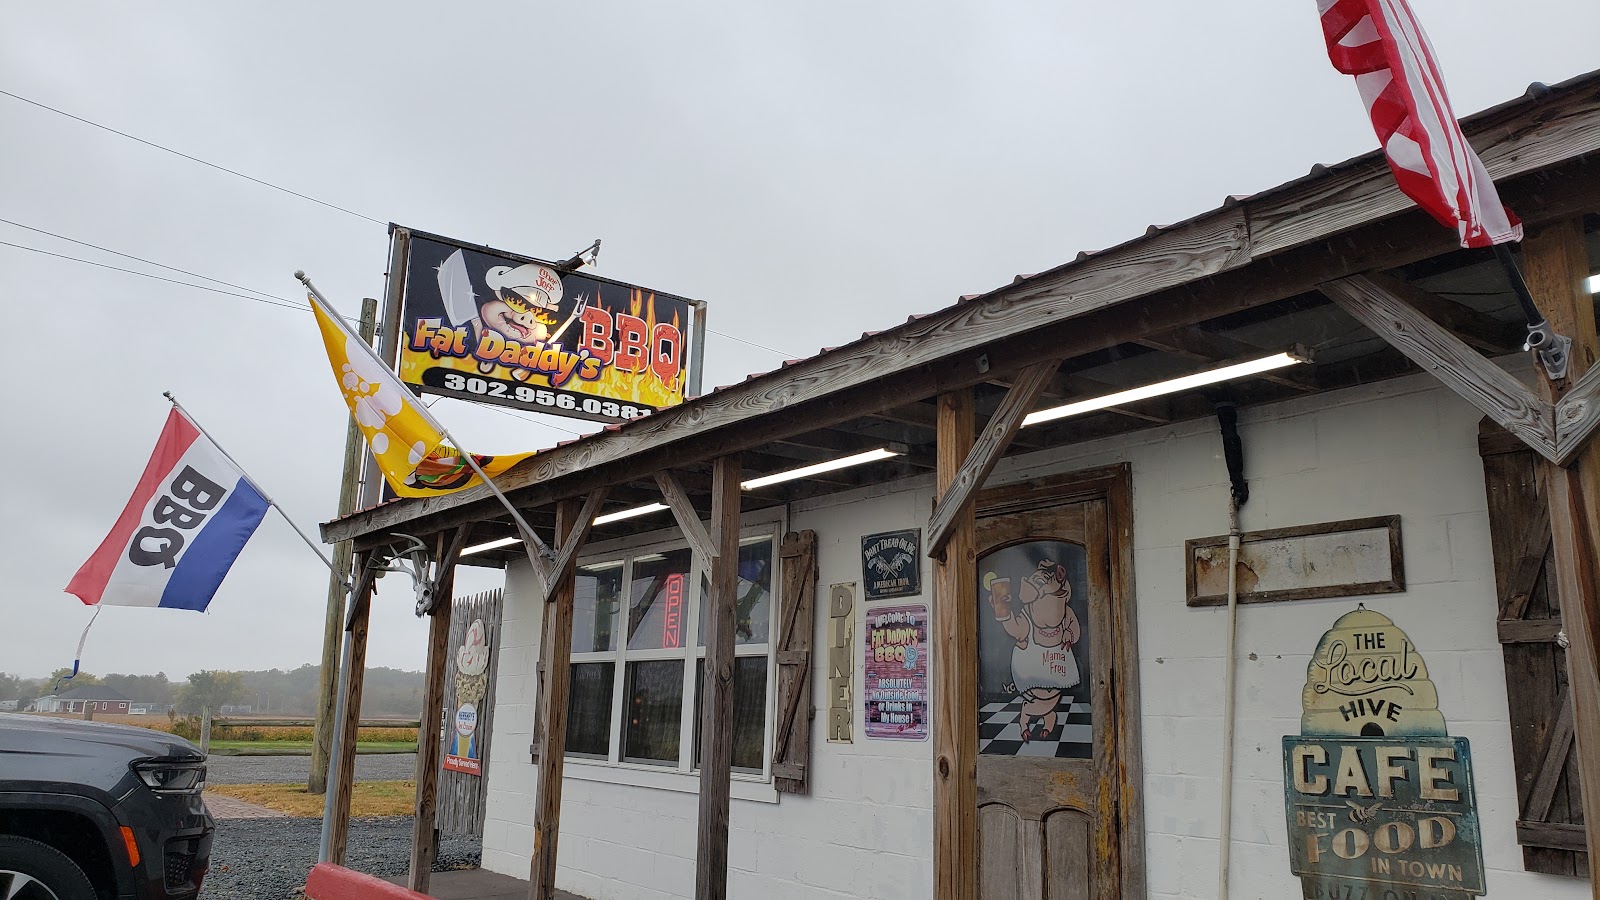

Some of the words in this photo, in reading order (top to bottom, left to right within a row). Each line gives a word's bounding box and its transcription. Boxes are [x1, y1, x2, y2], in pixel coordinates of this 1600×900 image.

[413, 318, 471, 355] Fat
[474, 325, 603, 386] Daddy's
[578, 306, 682, 391] BBQ
[128, 464, 228, 570] BBQ
[665, 579, 680, 646] OPEN
[875, 612, 904, 628] WELCOME
[905, 611, 916, 626] TO
[871, 629, 885, 649] FAT
[886, 628, 918, 647] DADDY'S
[1353, 632, 1385, 650] THE
[829, 586, 853, 741] DINER
[874, 646, 905, 663] BBQ
[1042, 651, 1066, 666] Mama
[1050, 661, 1066, 677] Frey
[1314, 639, 1418, 695] Local
[878, 678, 912, 689] ABSOLUTELY
[880, 690, 904, 700] Outside
[904, 690, 919, 700] Food
[878, 702, 886, 711] or
[886, 701, 905, 711] Drinks
[906, 701, 913, 712] in
[1339, 698, 1402, 723] HIVE
[881, 712, 890, 723] My
[890, 712, 909, 723] House
[1293, 744, 1459, 801] CAFE
[1297, 811, 1337, 829] BEST
[1306, 817, 1456, 864] FOOD
[1371, 857, 1390, 875] IN
[1397, 860, 1463, 882] TOWN
